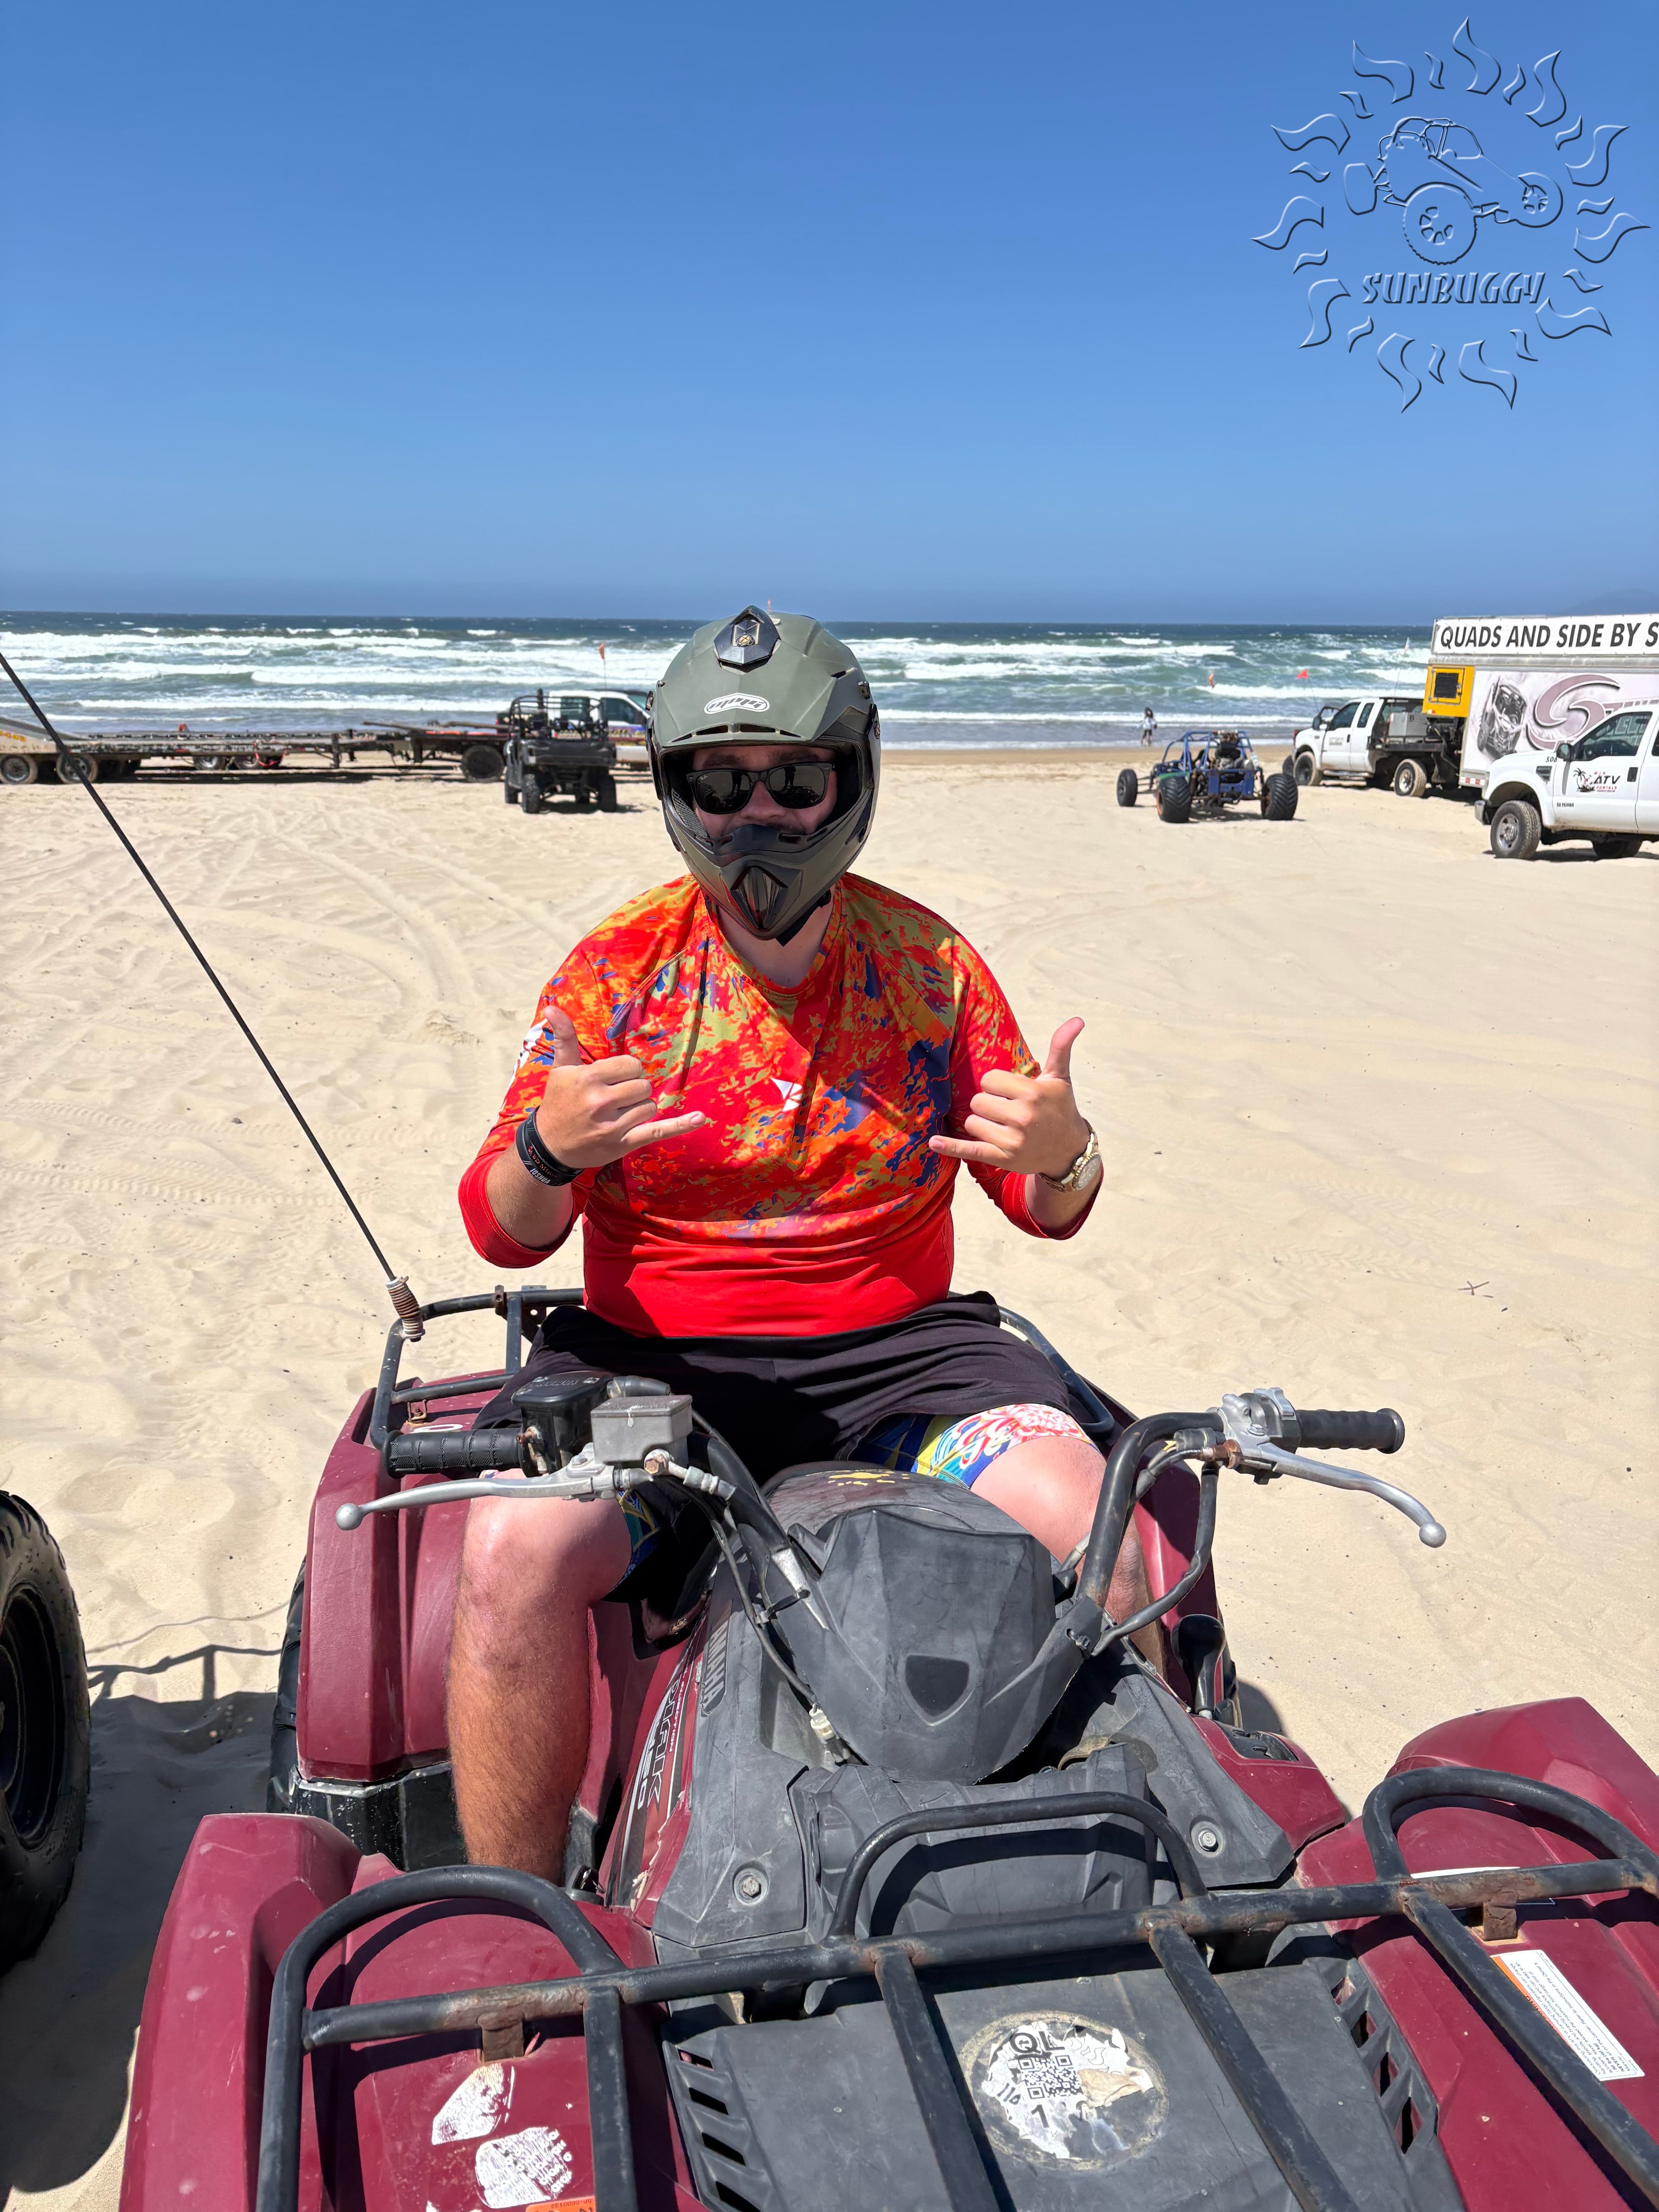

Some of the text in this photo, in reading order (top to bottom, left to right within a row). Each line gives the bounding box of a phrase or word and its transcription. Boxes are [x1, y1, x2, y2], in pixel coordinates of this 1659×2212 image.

[1440, 625, 1502, 649] QUADS
[1506, 625, 1551, 647] AND
[1556, 624, 1605, 648] SIDE
[1610, 623, 1642, 647] BY
[1593, 775, 1621, 785] ATV
[1009, 2031, 1065, 2054] QL
[1031, 2104, 1049, 2128] 1
